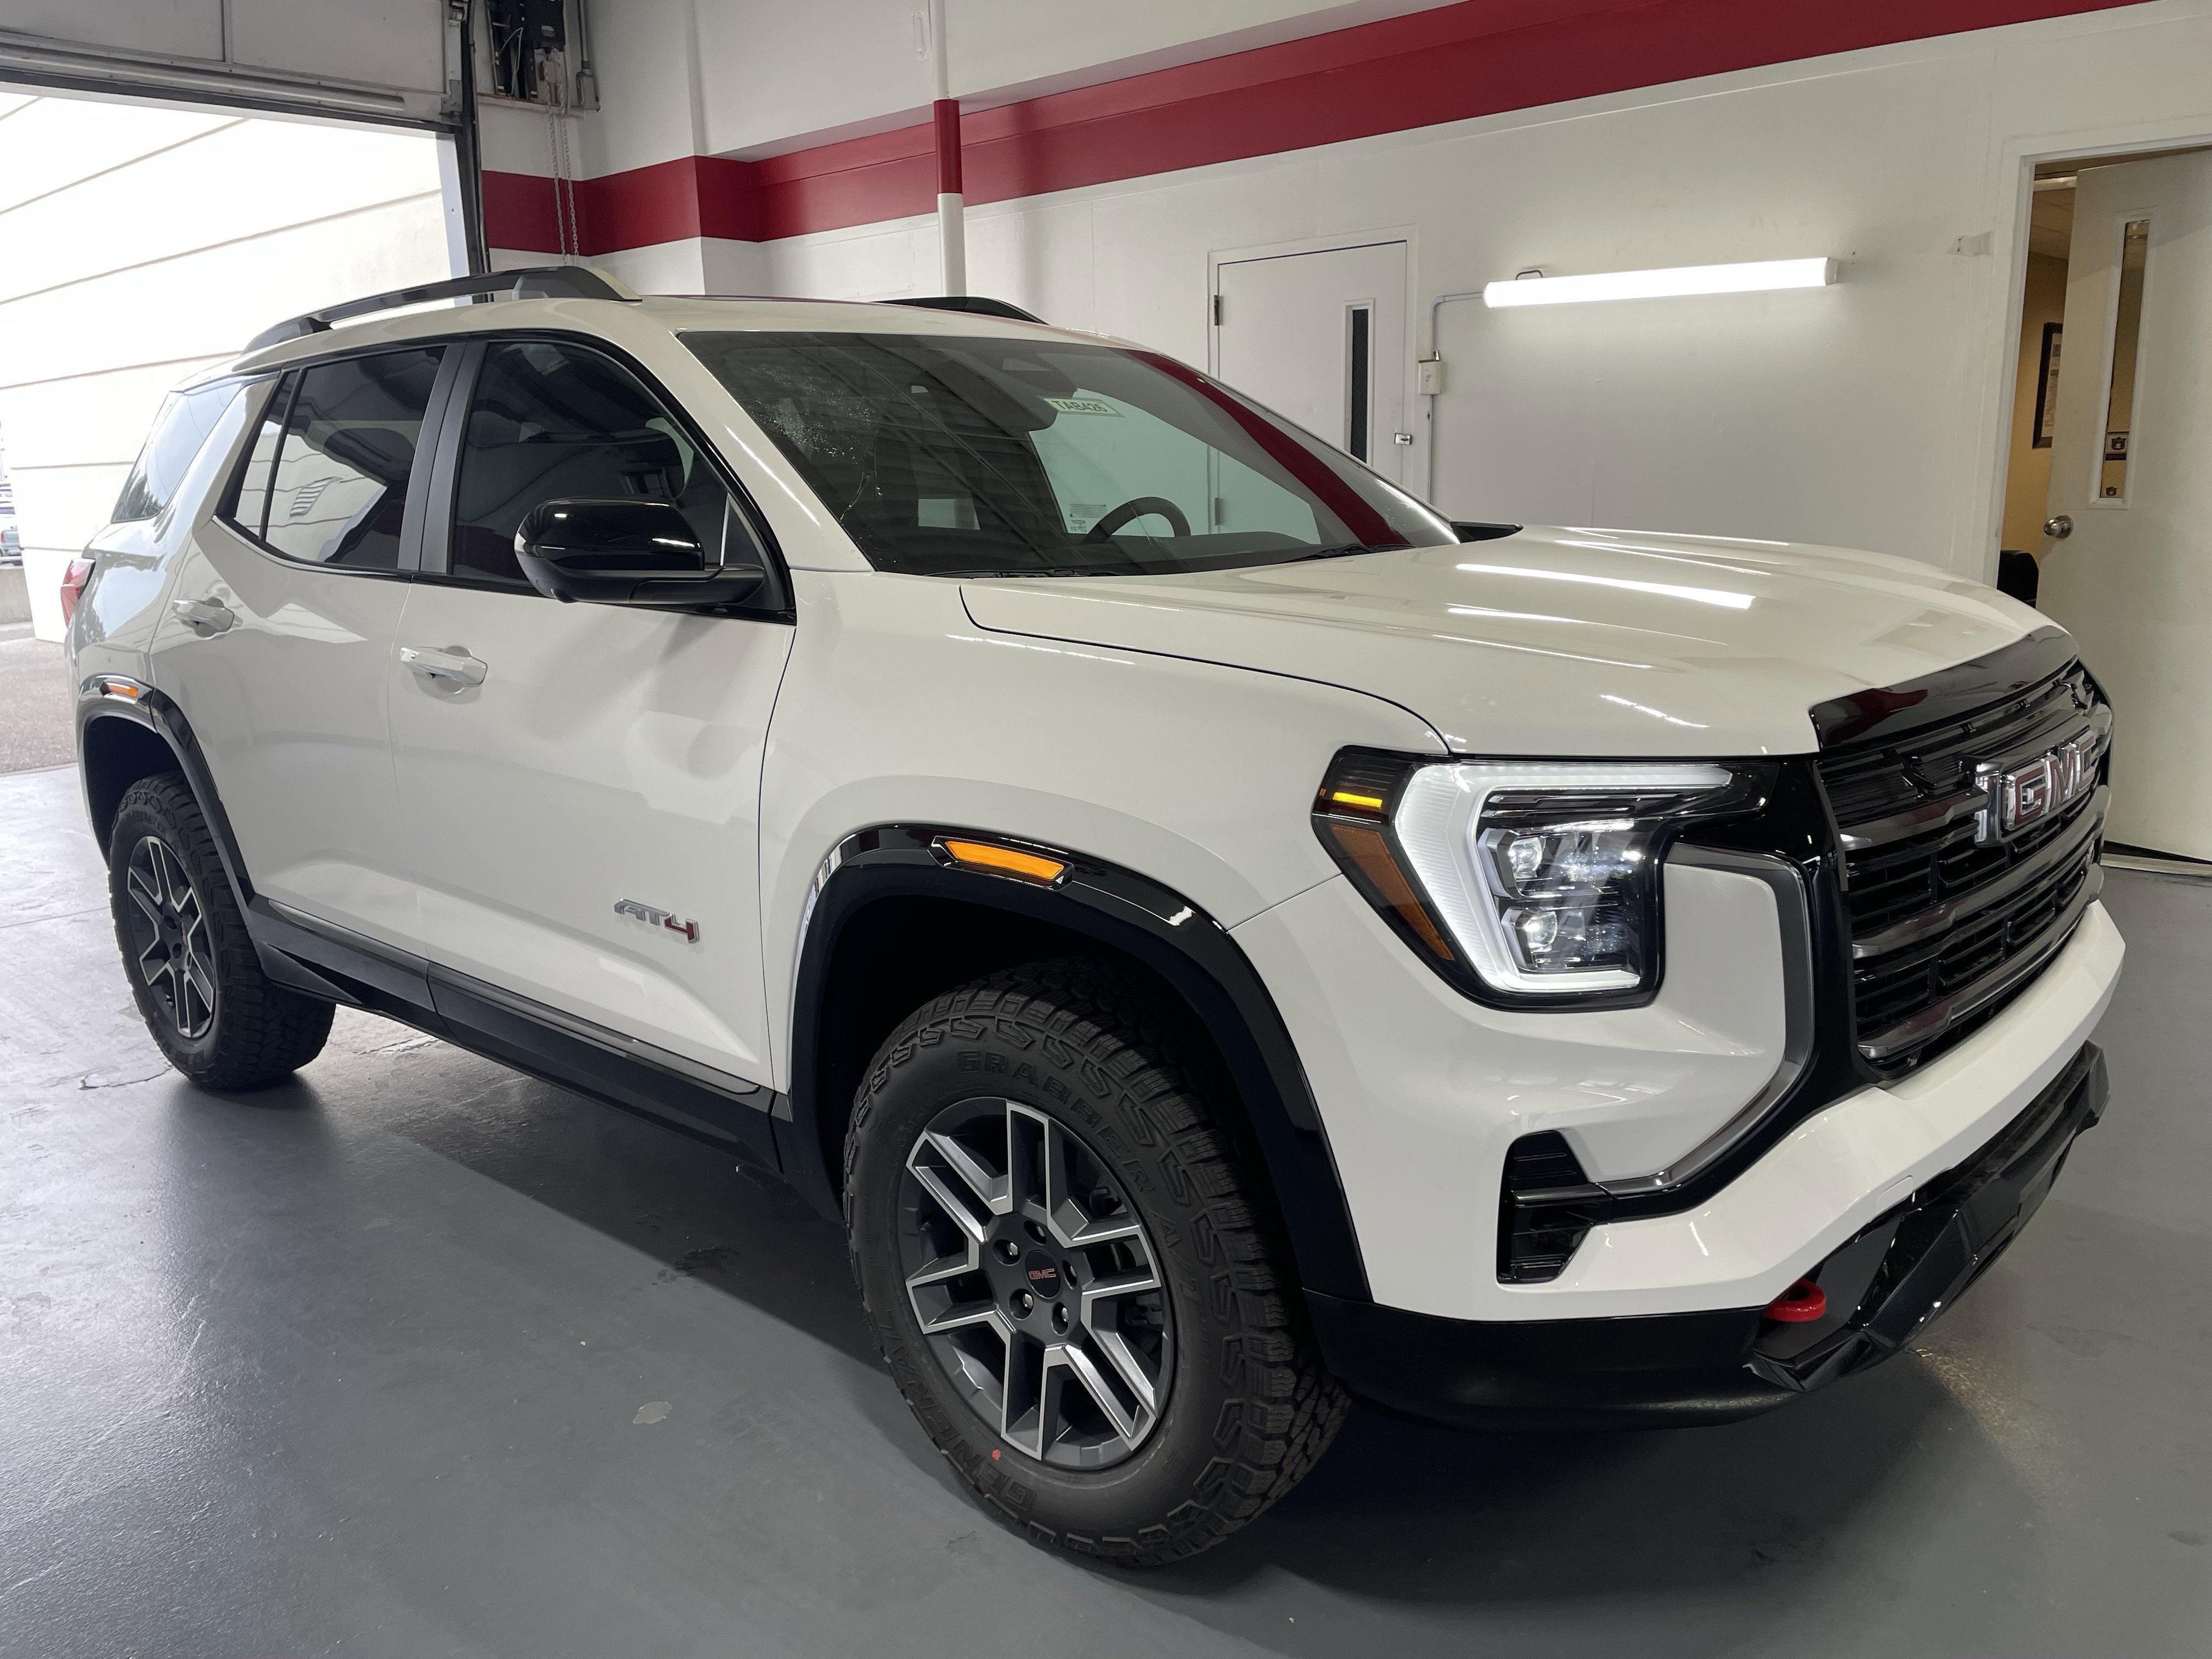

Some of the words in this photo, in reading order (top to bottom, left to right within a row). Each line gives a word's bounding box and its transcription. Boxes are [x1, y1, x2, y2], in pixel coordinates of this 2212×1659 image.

[2005, 730, 2096, 831] GMC
[614, 898, 700, 944] AT4
[957, 1049, 1156, 1193] GRABBER
[1028, 1268, 1057, 1280] GMC
